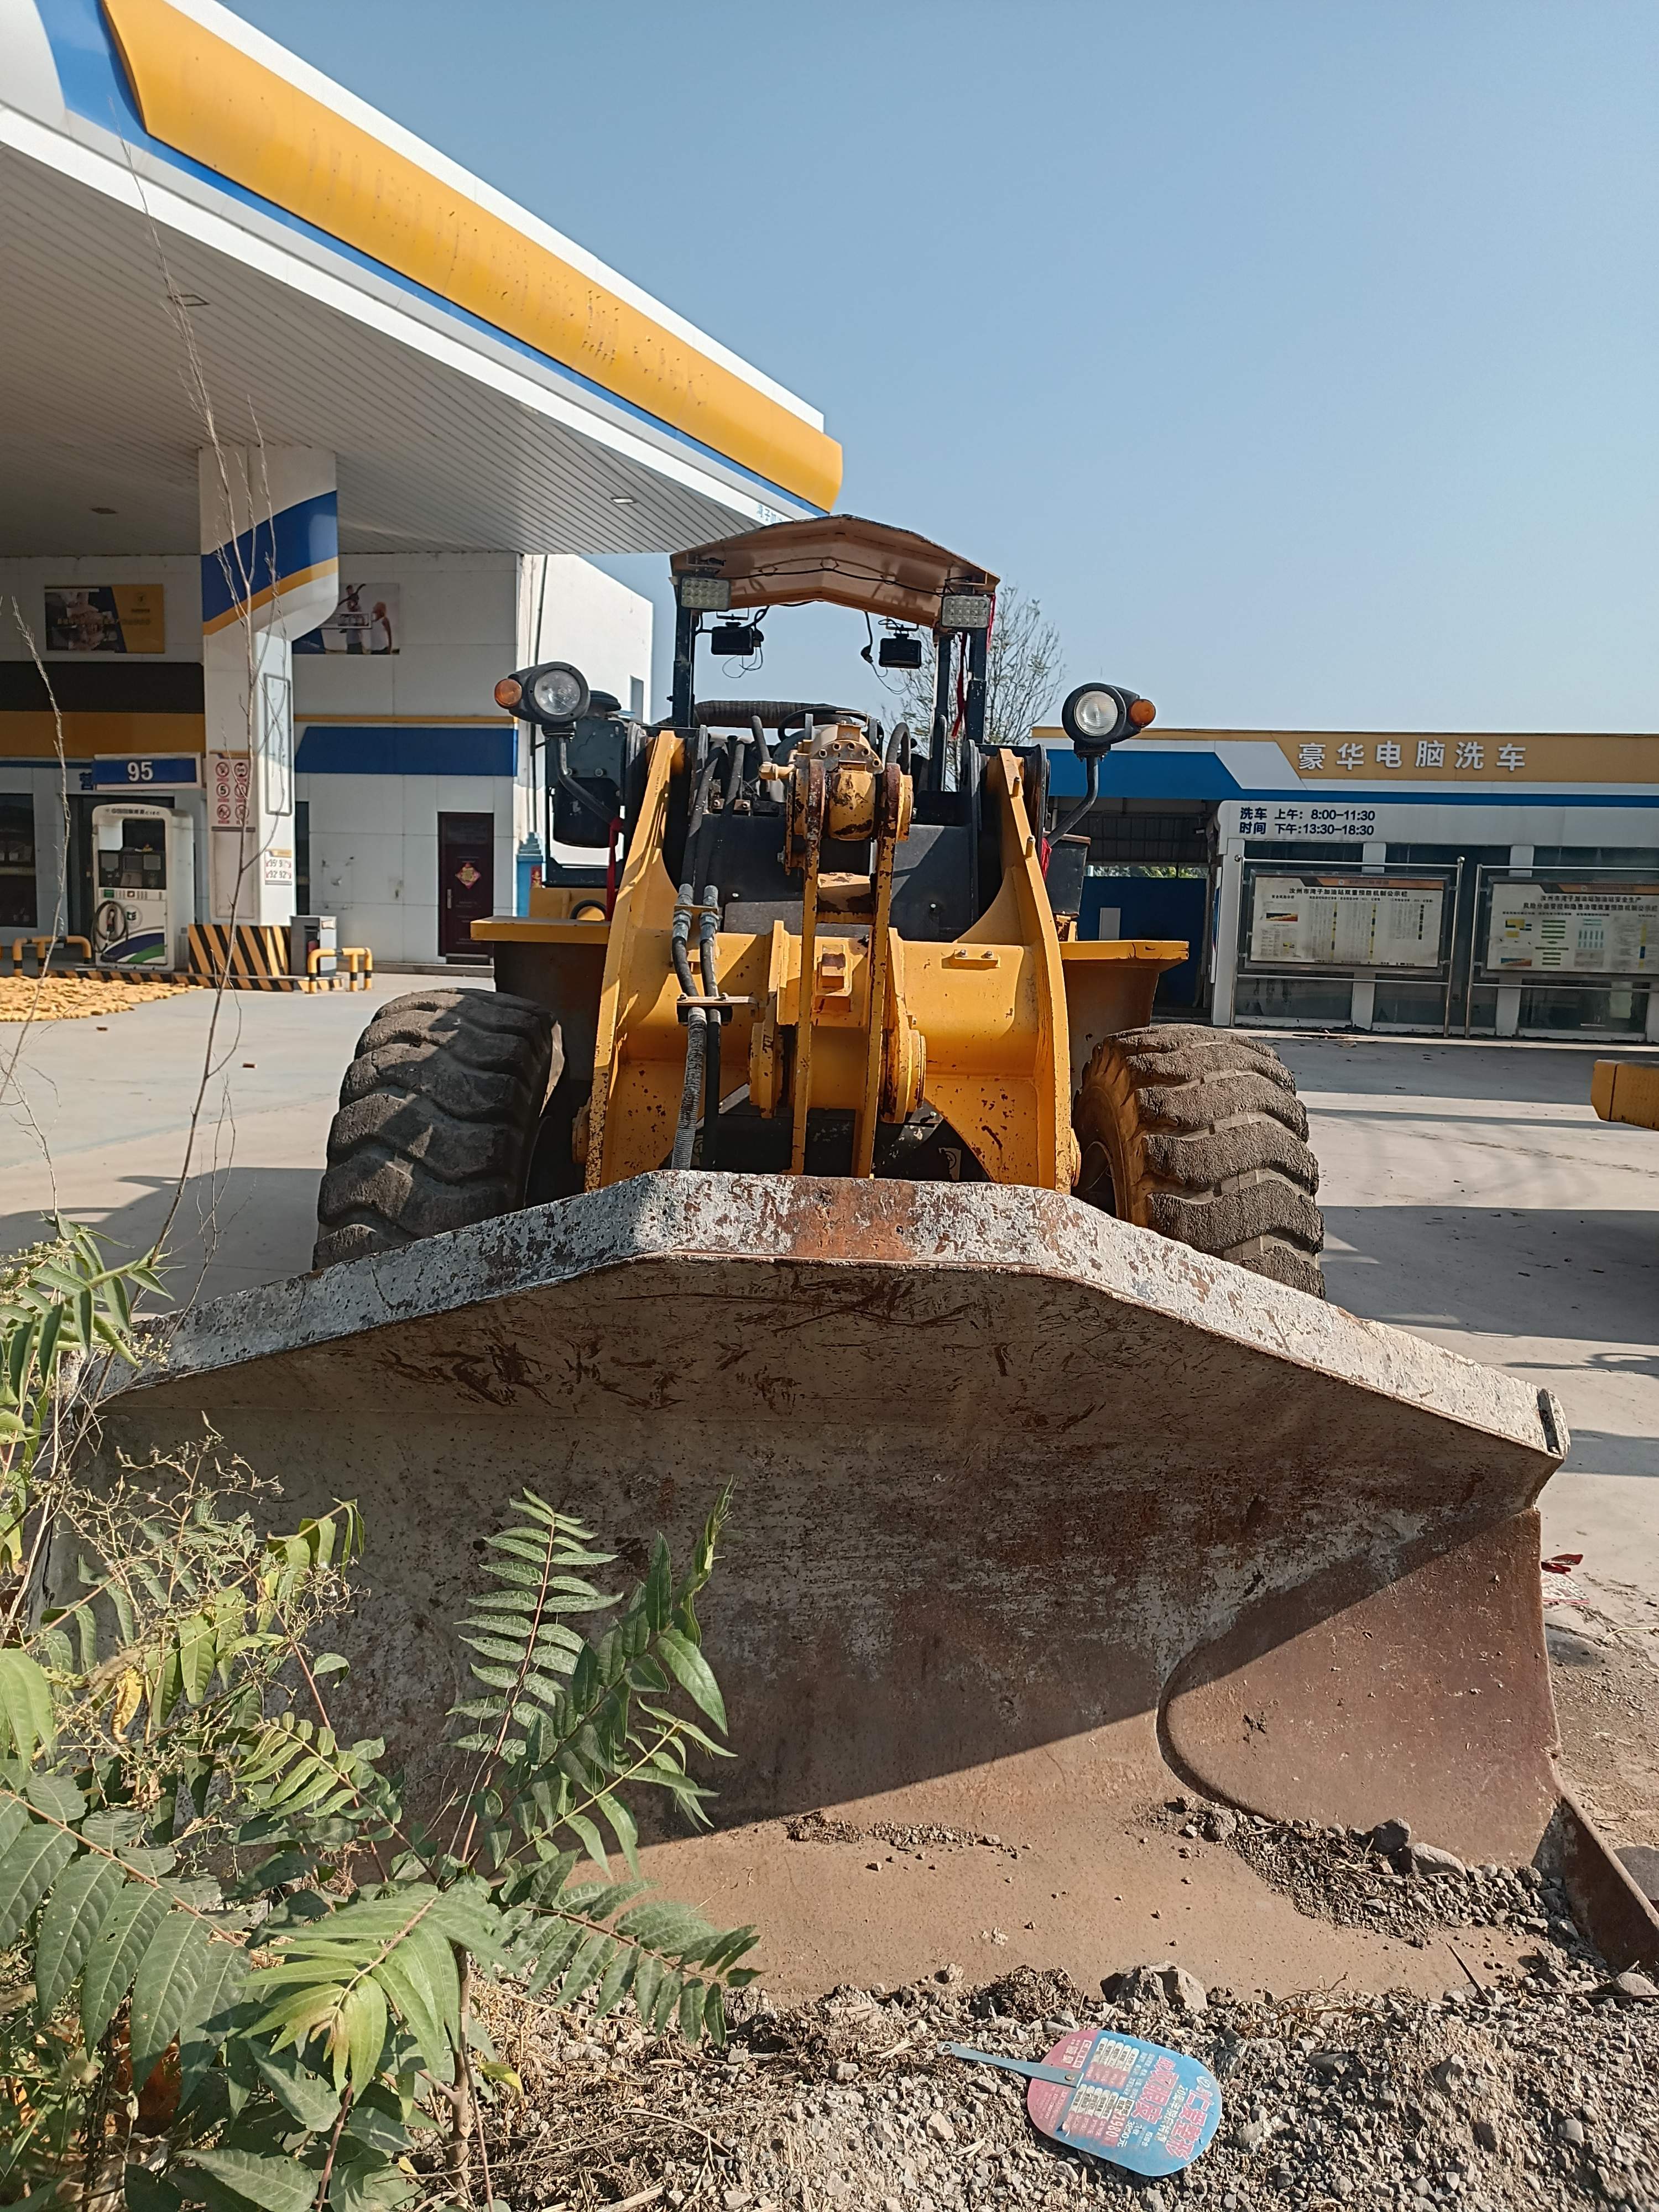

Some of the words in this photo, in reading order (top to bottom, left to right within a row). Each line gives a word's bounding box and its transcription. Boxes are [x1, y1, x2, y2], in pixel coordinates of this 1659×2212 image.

[1298, 740, 1526, 771] 豪华电脑洗车
[127, 761, 153, 781] 95
[1240, 807, 1267, 820] 洗车
[1311, 809, 1375, 821] 8:00-11:30
[1239, 822, 1266, 834] 时间
[1165, 2088, 1214, 2161] 仁爱整形
